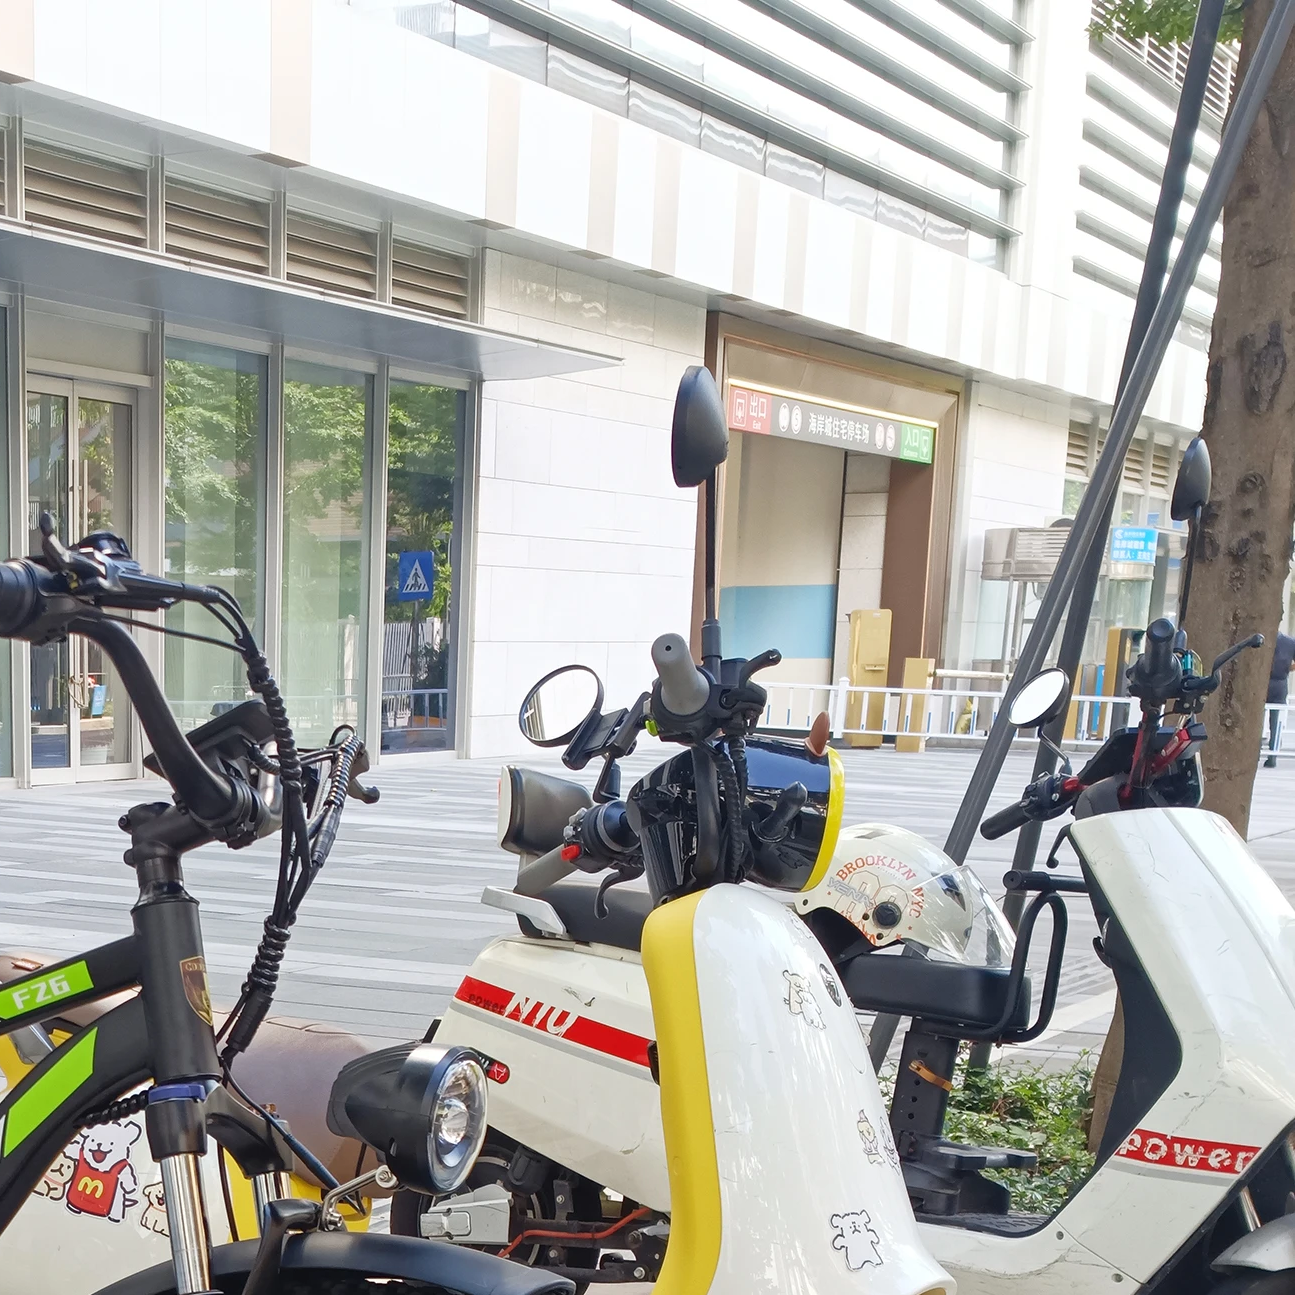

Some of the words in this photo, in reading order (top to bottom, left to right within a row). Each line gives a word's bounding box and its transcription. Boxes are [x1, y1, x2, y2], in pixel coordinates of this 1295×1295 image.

[749, 394, 767, 419] 出口
[808, 412, 870, 444] 海岸城住宅停车场
[904, 426, 919, 447] 入口
[836, 855, 917, 882] BROOKLYN
[909, 886, 925, 919] NYC
[504, 992, 579, 1037] NIU
